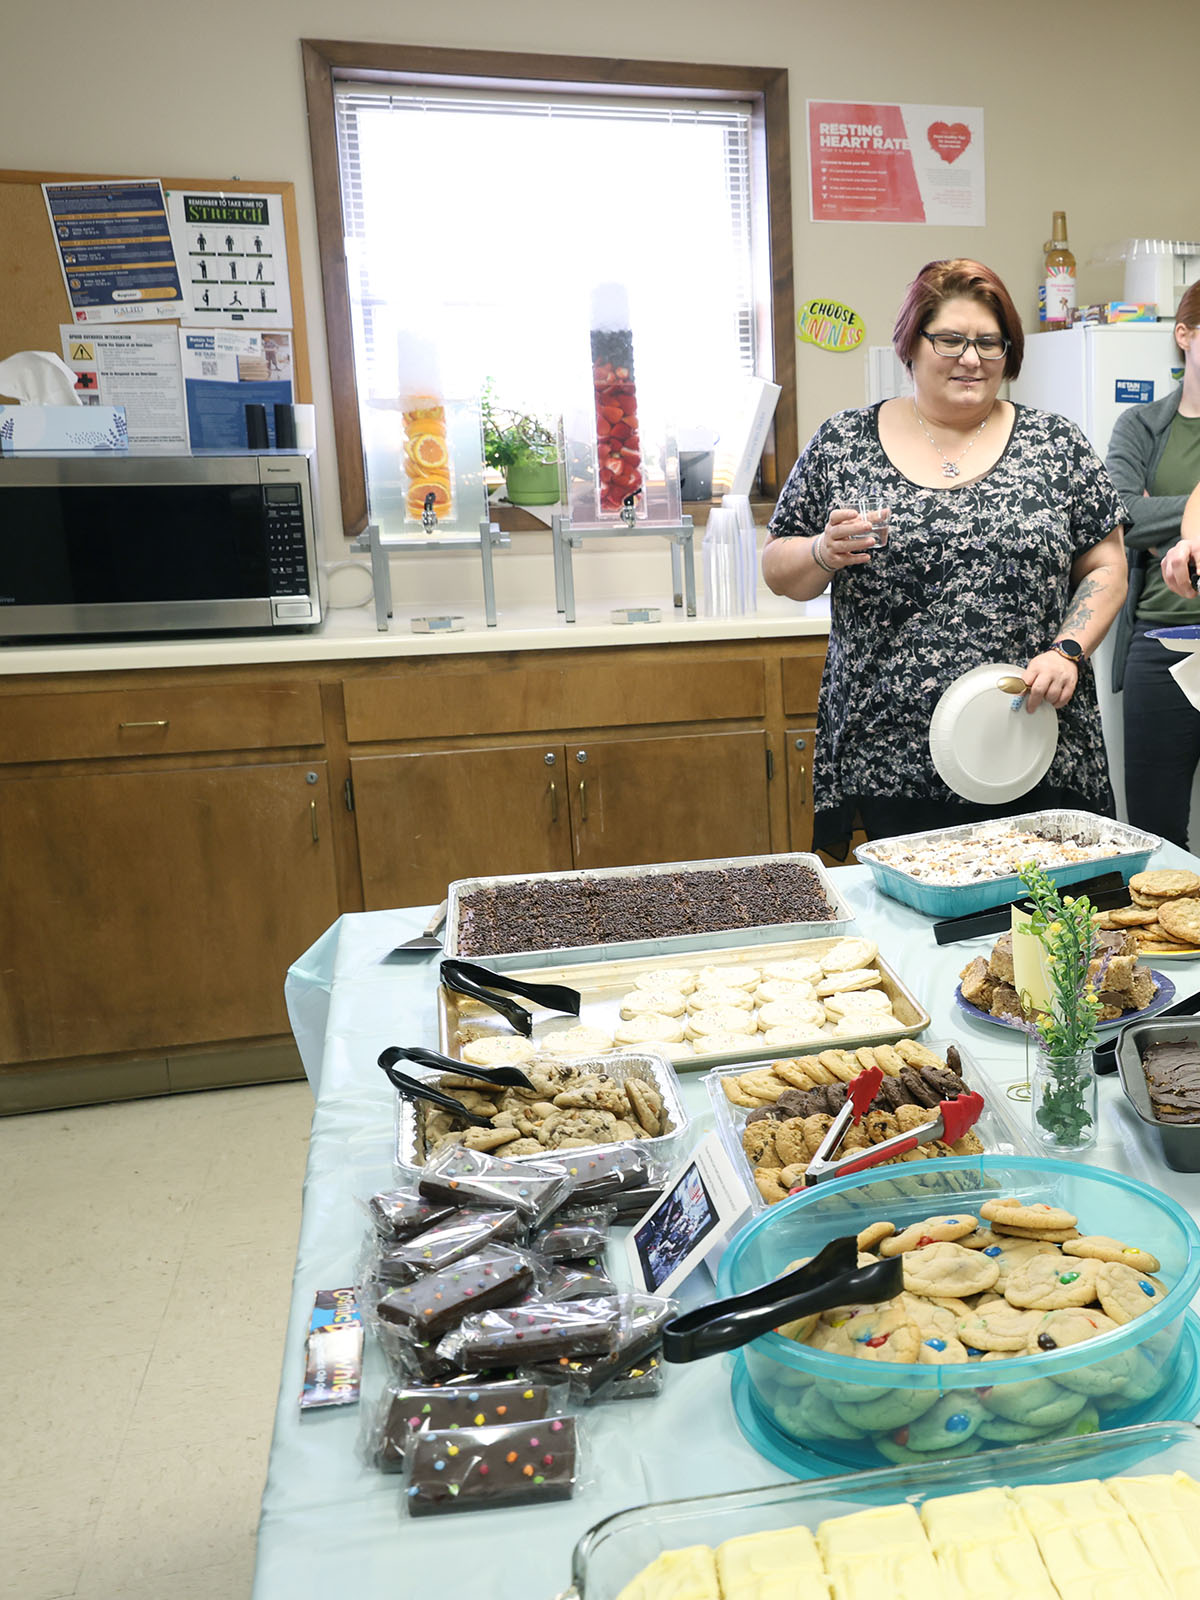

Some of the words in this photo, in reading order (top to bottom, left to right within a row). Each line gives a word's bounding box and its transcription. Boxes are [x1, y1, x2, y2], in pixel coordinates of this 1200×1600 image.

[820, 122, 884, 137] RESTING
[820, 135, 871, 149] HEART
[873, 137, 911, 150] RATE
[188, 198, 218, 206] REMEMBER
[219, 199, 227, 207] TO
[227, 199, 241, 207] TAKE
[242, 200, 255, 208] TIME
[255, 201, 264, 209] TO
[189, 206, 263, 223] STRETCH
[809, 302, 856, 325] CHOOSE
[801, 312, 863, 347] KINDNESS
